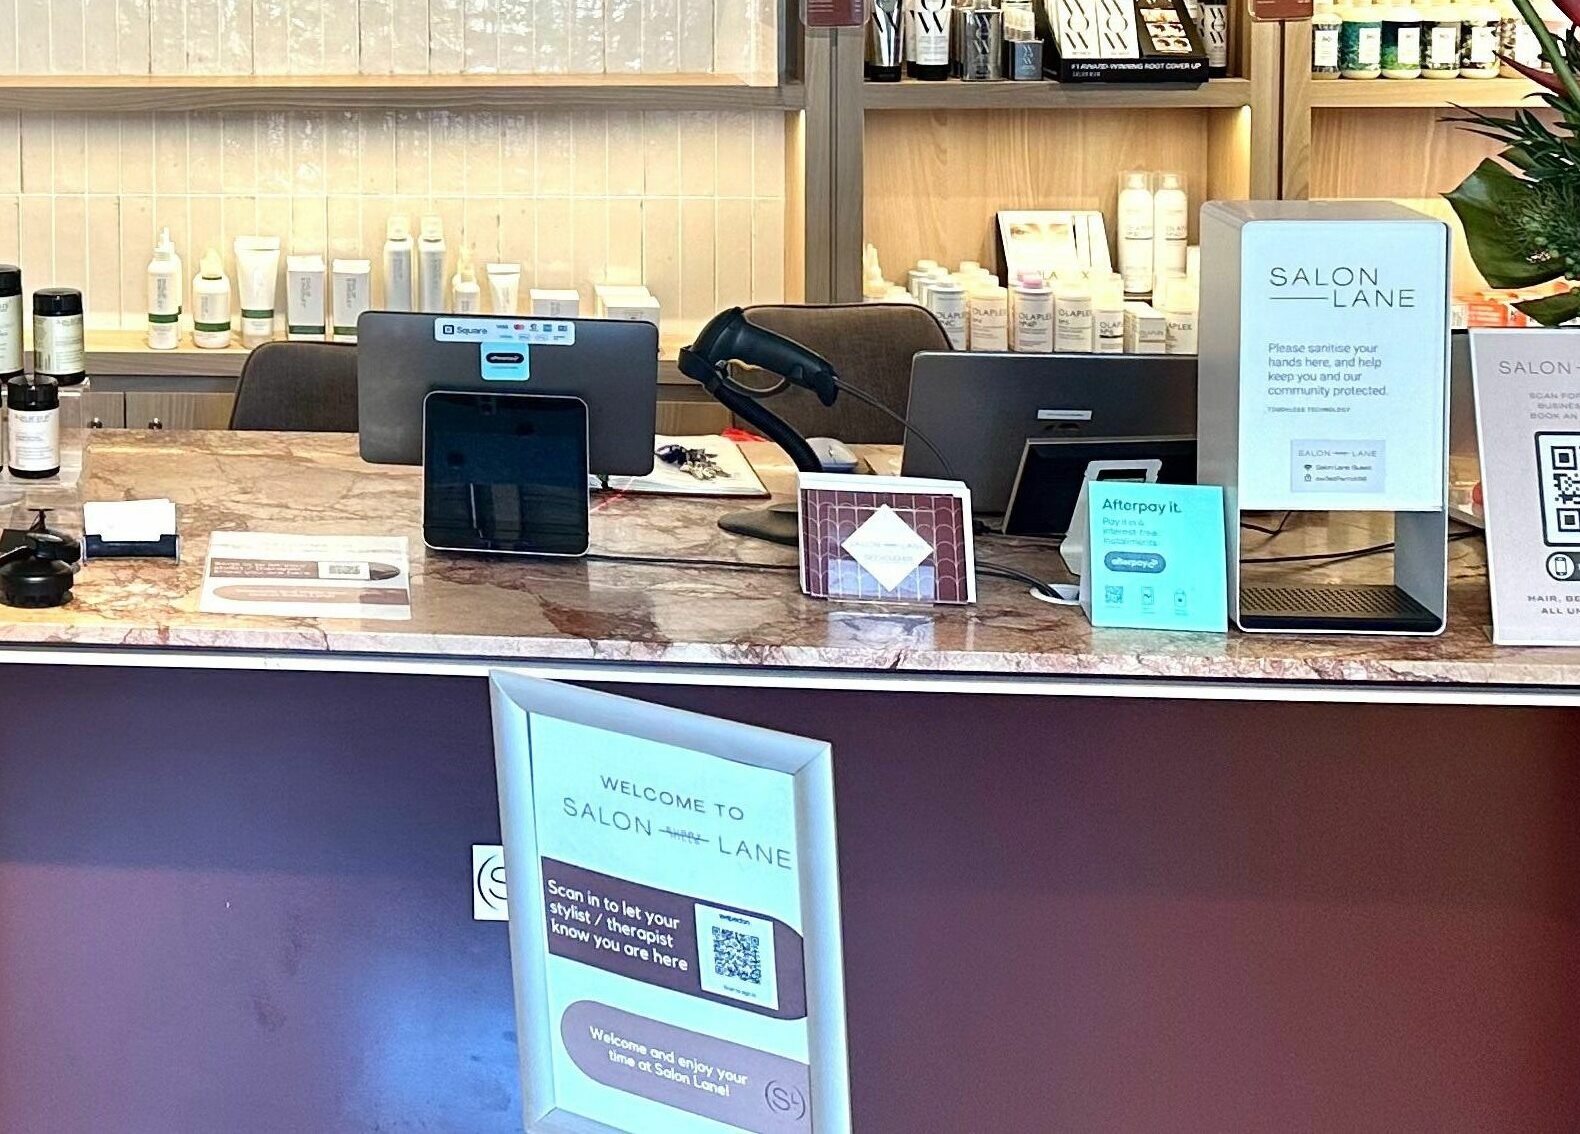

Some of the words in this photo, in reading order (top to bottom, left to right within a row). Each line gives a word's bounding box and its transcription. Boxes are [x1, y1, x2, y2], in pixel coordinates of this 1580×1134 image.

[1144, 62, 1165, 70] ROOT
[1165, 62, 1189, 70] COVER
[1269, 266, 1378, 287] SALON
[1333, 289, 1416, 308] LANE
[456, 326, 488, 335] Square
[1268, 343, 1305, 354] Please
[1308, 343, 1350, 354] sanitise
[1353, 344, 1379, 357] your
[1268, 357, 1303, 368] hands
[1334, 357, 1356, 368] and
[1358, 357, 1382, 370] help
[1498, 361, 1572, 374] SALON
[1268, 371, 1294, 384] keep
[1296, 373, 1317, 384] you
[1319, 371, 1341, 382] and
[1343, 373, 1362, 382] our
[1268, 386, 1330, 398] community
[1332, 385, 1389, 398] protected.
[1298, 449, 1332, 457] SALON
[1102, 498, 1167, 514] Afterpay
[1102, 517, 1120, 527] Pay
[1541, 607, 1564, 615] ALL
[600, 774, 705, 814] WELCOME
[714, 802, 744, 821] TO
[562, 797, 652, 836] SALON
[717, 834, 792, 870] LANE
[547, 879, 585, 904] Scan
[587, 889, 601, 907] in
[603, 896, 619, 913] to
[622, 900, 642, 921] let
[644, 910, 681, 930] your
[549, 900, 591, 925] stylist
[594, 914, 603, 927] /
[606, 918, 674, 949] therapist
[550, 918, 591, 943] know
[593, 932, 621, 953] you
[623, 944, 649, 962] are
[652, 950, 689, 972] here
[589, 1025, 648, 1055] Welcome
[650, 1047, 676, 1065] and
[677, 1056, 715, 1079] enjoy
[716, 1066, 749, 1086] your
[607, 1049, 636, 1068] time
[638, 1058, 653, 1073] at
[654, 1062, 691, 1086] Salon
